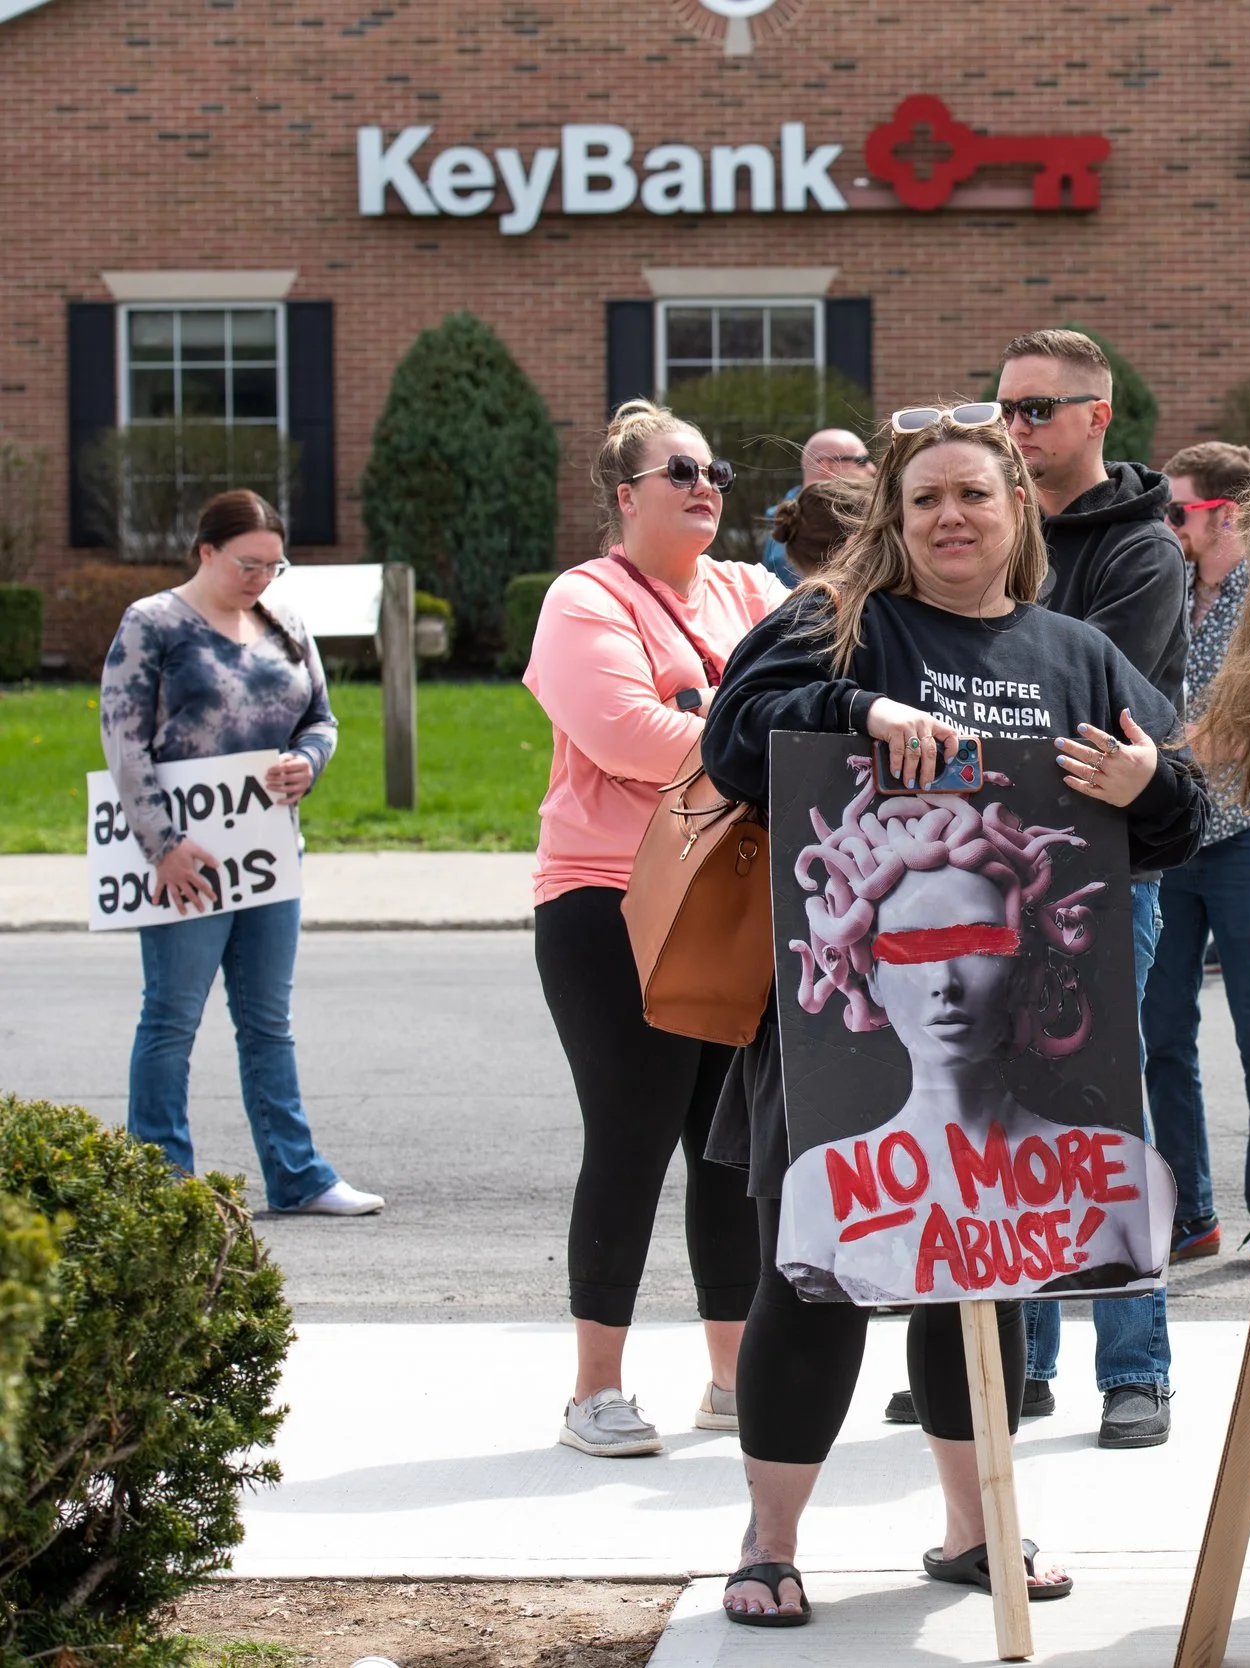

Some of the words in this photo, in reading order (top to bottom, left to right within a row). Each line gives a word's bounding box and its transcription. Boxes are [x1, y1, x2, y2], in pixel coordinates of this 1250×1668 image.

[357, 122, 847, 234] KeyBank
[971, 677, 1041, 699] COFFEE
[973, 702, 1051, 728] RACISM
[825, 1129, 930, 1222] NO
[945, 1120, 1141, 1214] MORE
[915, 1202, 1106, 1293] ABUSE!
